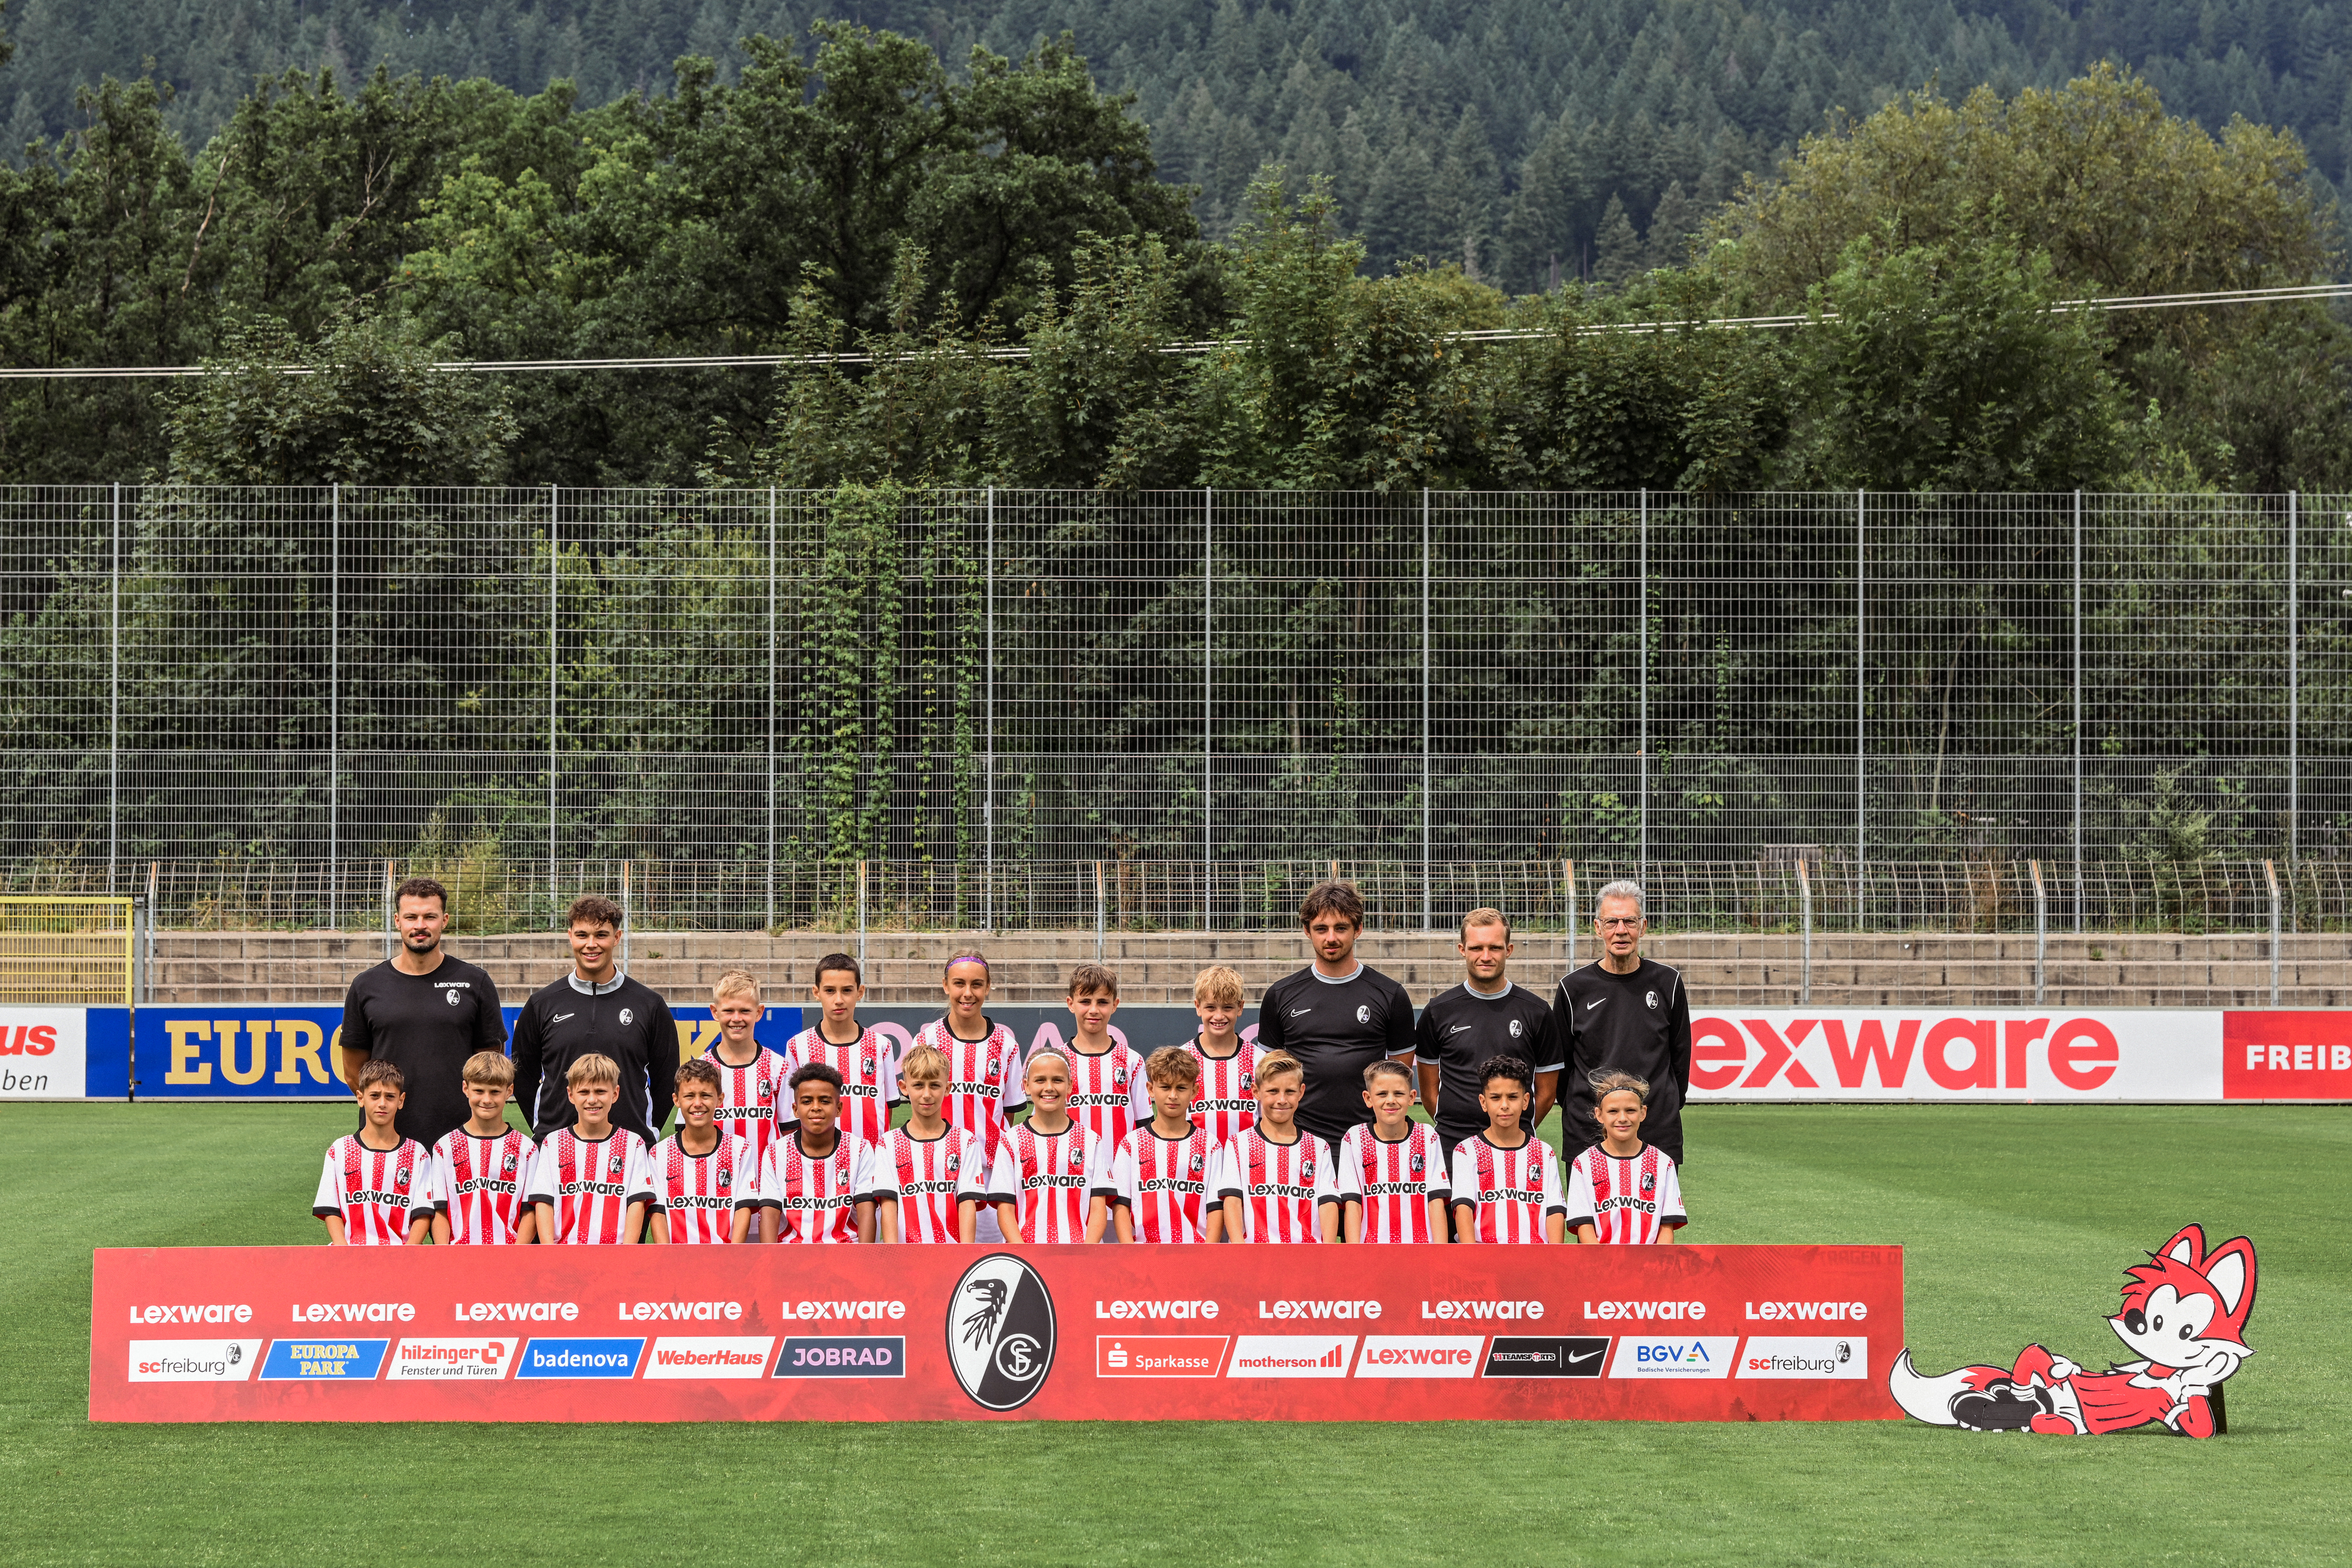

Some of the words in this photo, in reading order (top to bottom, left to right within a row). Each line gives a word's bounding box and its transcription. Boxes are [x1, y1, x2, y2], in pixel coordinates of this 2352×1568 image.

[1689, 1017, 2119, 1091] exware
[2247, 1045, 2352, 1070] FREIB
[2, 1069, 47, 1091] ben
[840, 1084, 878, 1097] ware
[951, 1082, 1000, 1098] xware
[714, 1107, 773, 1120] exware
[1188, 1100, 1256, 1113] Lexware
[455, 1178, 516, 1194] Lexware
[559, 1182, 624, 1195] Lexware
[1022, 1176, 1086, 1189] Lexware
[1139, 1179, 1204, 1193] Lexware
[1364, 1183, 1426, 1195] Lexware
[345, 1191, 410, 1207] Lexware
[1248, 1184, 1315, 1199] Lexware
[1478, 1189, 1544, 1203] Lexware
[666, 1197, 732, 1208] Lexware
[784, 1195, 853, 1209] Lexware
[1594, 1197, 1655, 1213] Lexware
[130, 1304, 252, 1323] Lexware
[292, 1303, 415, 1322] Lexware
[455, 1302, 579, 1321] Lexware
[619, 1302, 742, 1320] Lexware
[783, 1300, 906, 1320] Lexware
[1096, 1300, 1219, 1319] Lexware
[1259, 1300, 1382, 1319] Lexware
[1422, 1300, 1544, 1319] Lexware
[1584, 1301, 1706, 1320] Lexware
[1745, 1302, 1867, 1320] Lexware
[290, 1345, 360, 1359] EUROPA
[402, 1345, 479, 1364] hilzinger
[534, 1349, 628, 1367] badenova
[657, 1350, 763, 1365] WeberHaus
[792, 1348, 892, 1366] JOBRAD
[1367, 1349, 1472, 1365] Lexware
[139, 1358, 225, 1375] scfreiburg
[1136, 1355, 1209, 1371] Sparkasse
[1239, 1355, 1316, 1367] motherson
[1749, 1355, 1834, 1373] scfreiburg
[401, 1366, 440, 1375] Fenster
[443, 1365, 461, 1375] und
[467, 1365, 497, 1375] Türen
